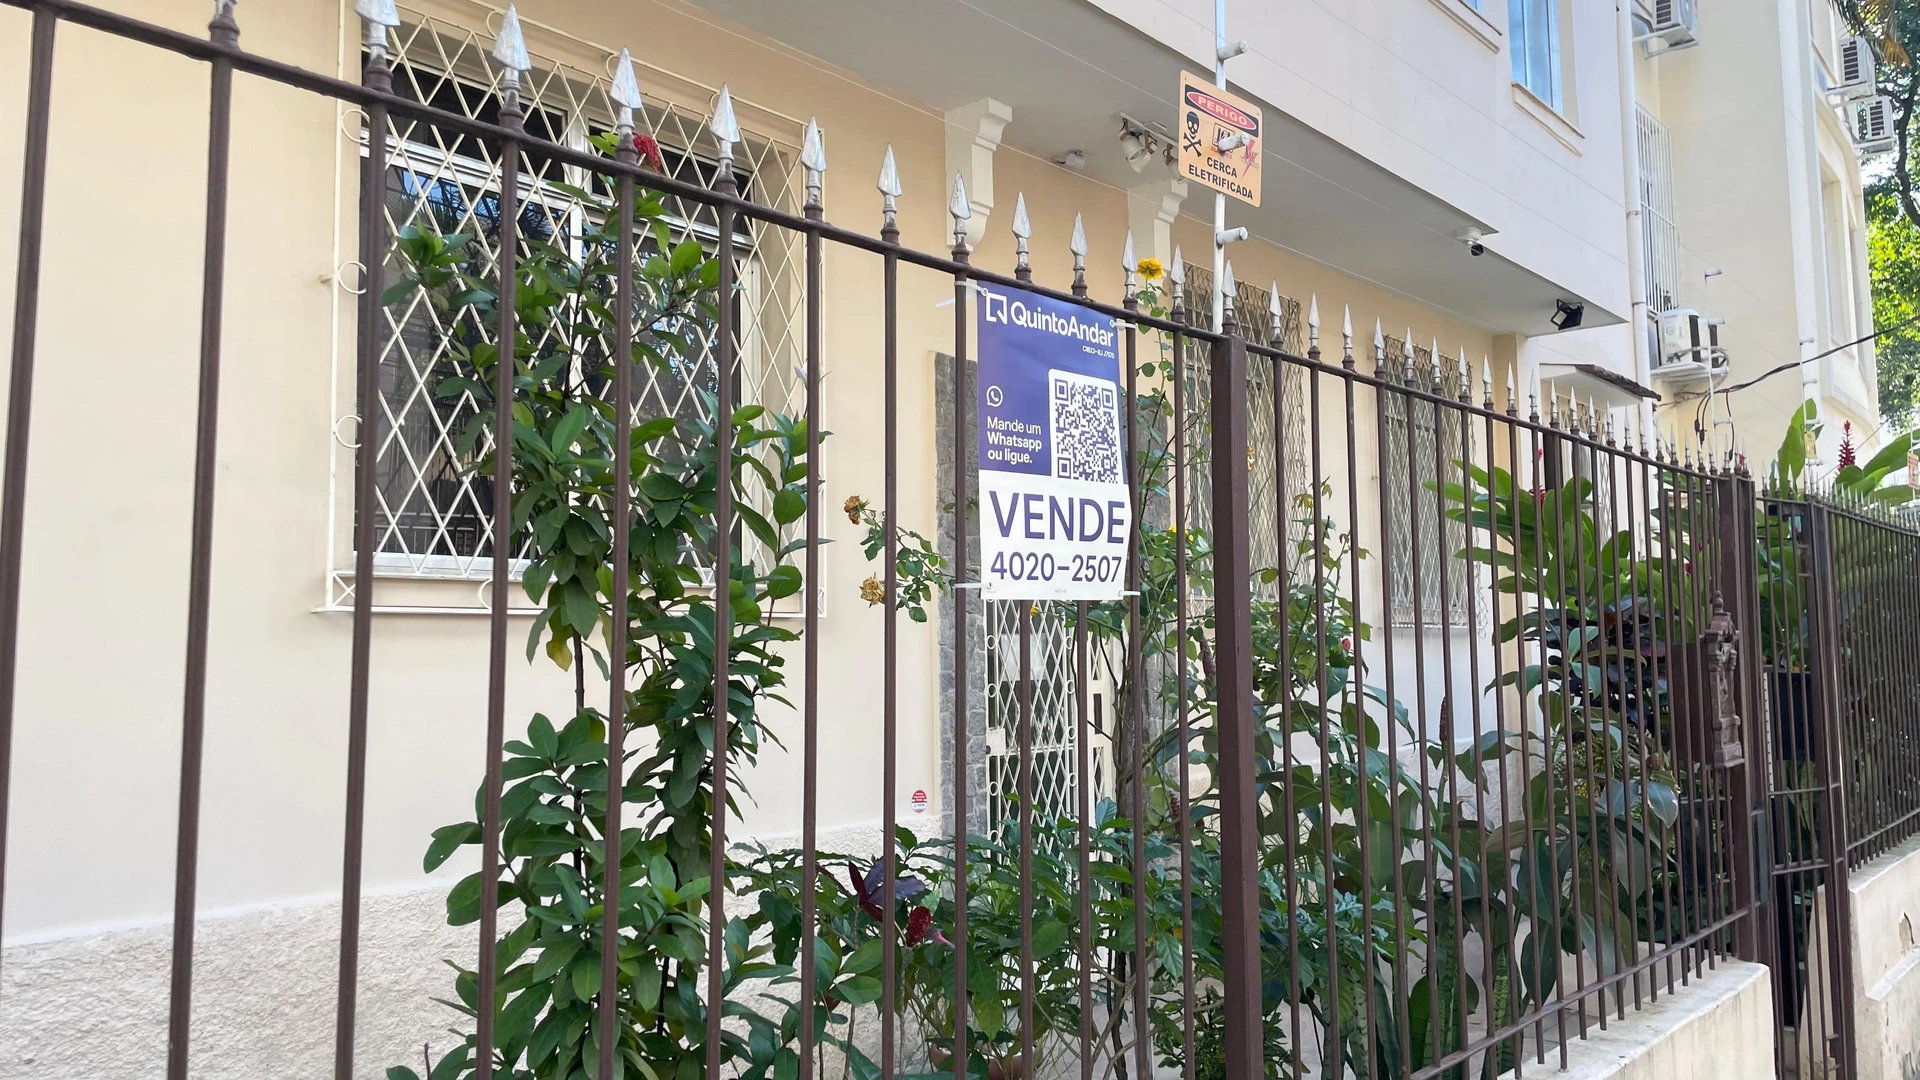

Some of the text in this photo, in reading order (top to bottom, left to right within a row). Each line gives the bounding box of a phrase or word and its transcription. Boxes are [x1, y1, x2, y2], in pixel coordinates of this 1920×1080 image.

[1198, 95, 1248, 126] PERIGO
[1188, 164, 1253, 200] ELETRIFICADA
[1206, 156, 1238, 178] CERCA
[1010, 301, 1113, 347] QuintoAndar
[987, 416, 1042, 435] Mande um
[986, 431, 1042, 452] Whatsapp
[987, 448, 1033, 465] ou ligue.
[989, 490, 1125, 544] VENDE
[990, 551, 1122, 582] 4020-2507
